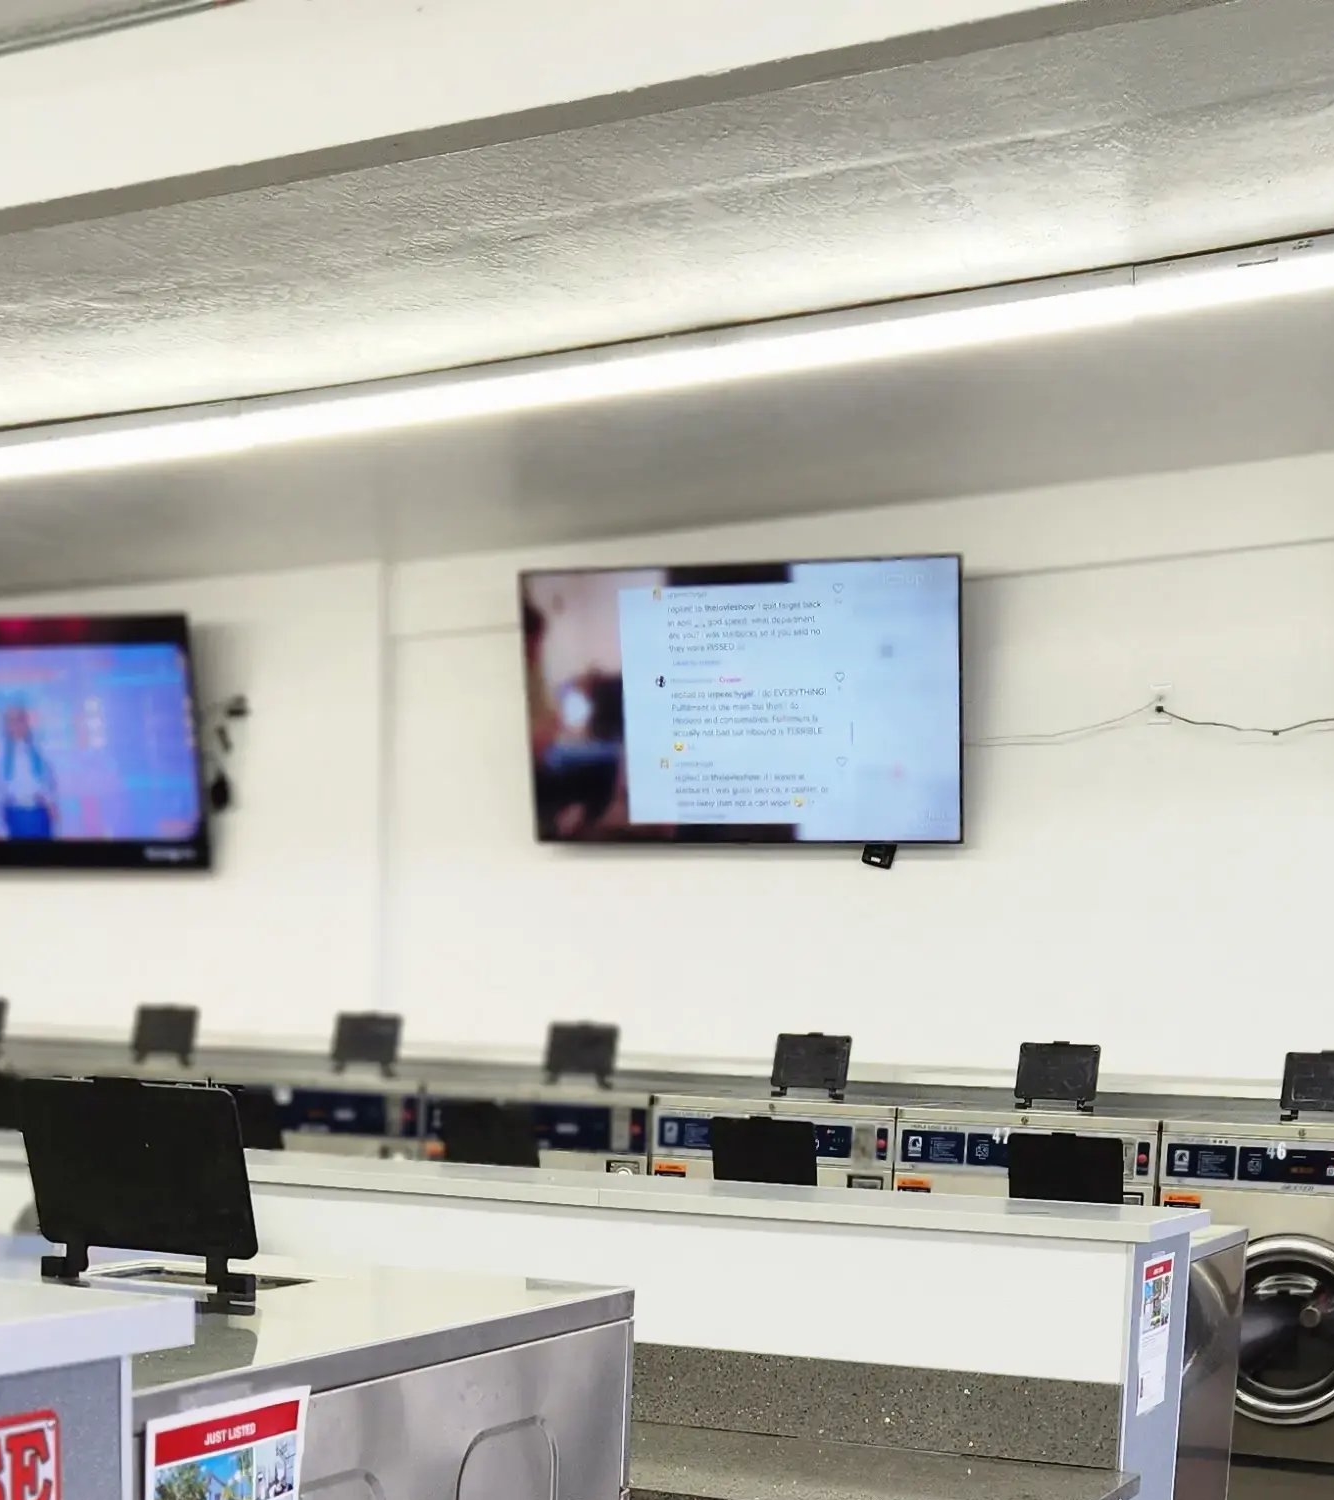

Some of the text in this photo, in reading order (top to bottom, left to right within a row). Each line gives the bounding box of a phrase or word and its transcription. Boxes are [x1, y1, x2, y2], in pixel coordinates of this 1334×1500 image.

[992, 1126, 1011, 1145] 47
[1266, 1140, 1288, 1161] 46
[203, 1421, 257, 1447] JUST LISTED
